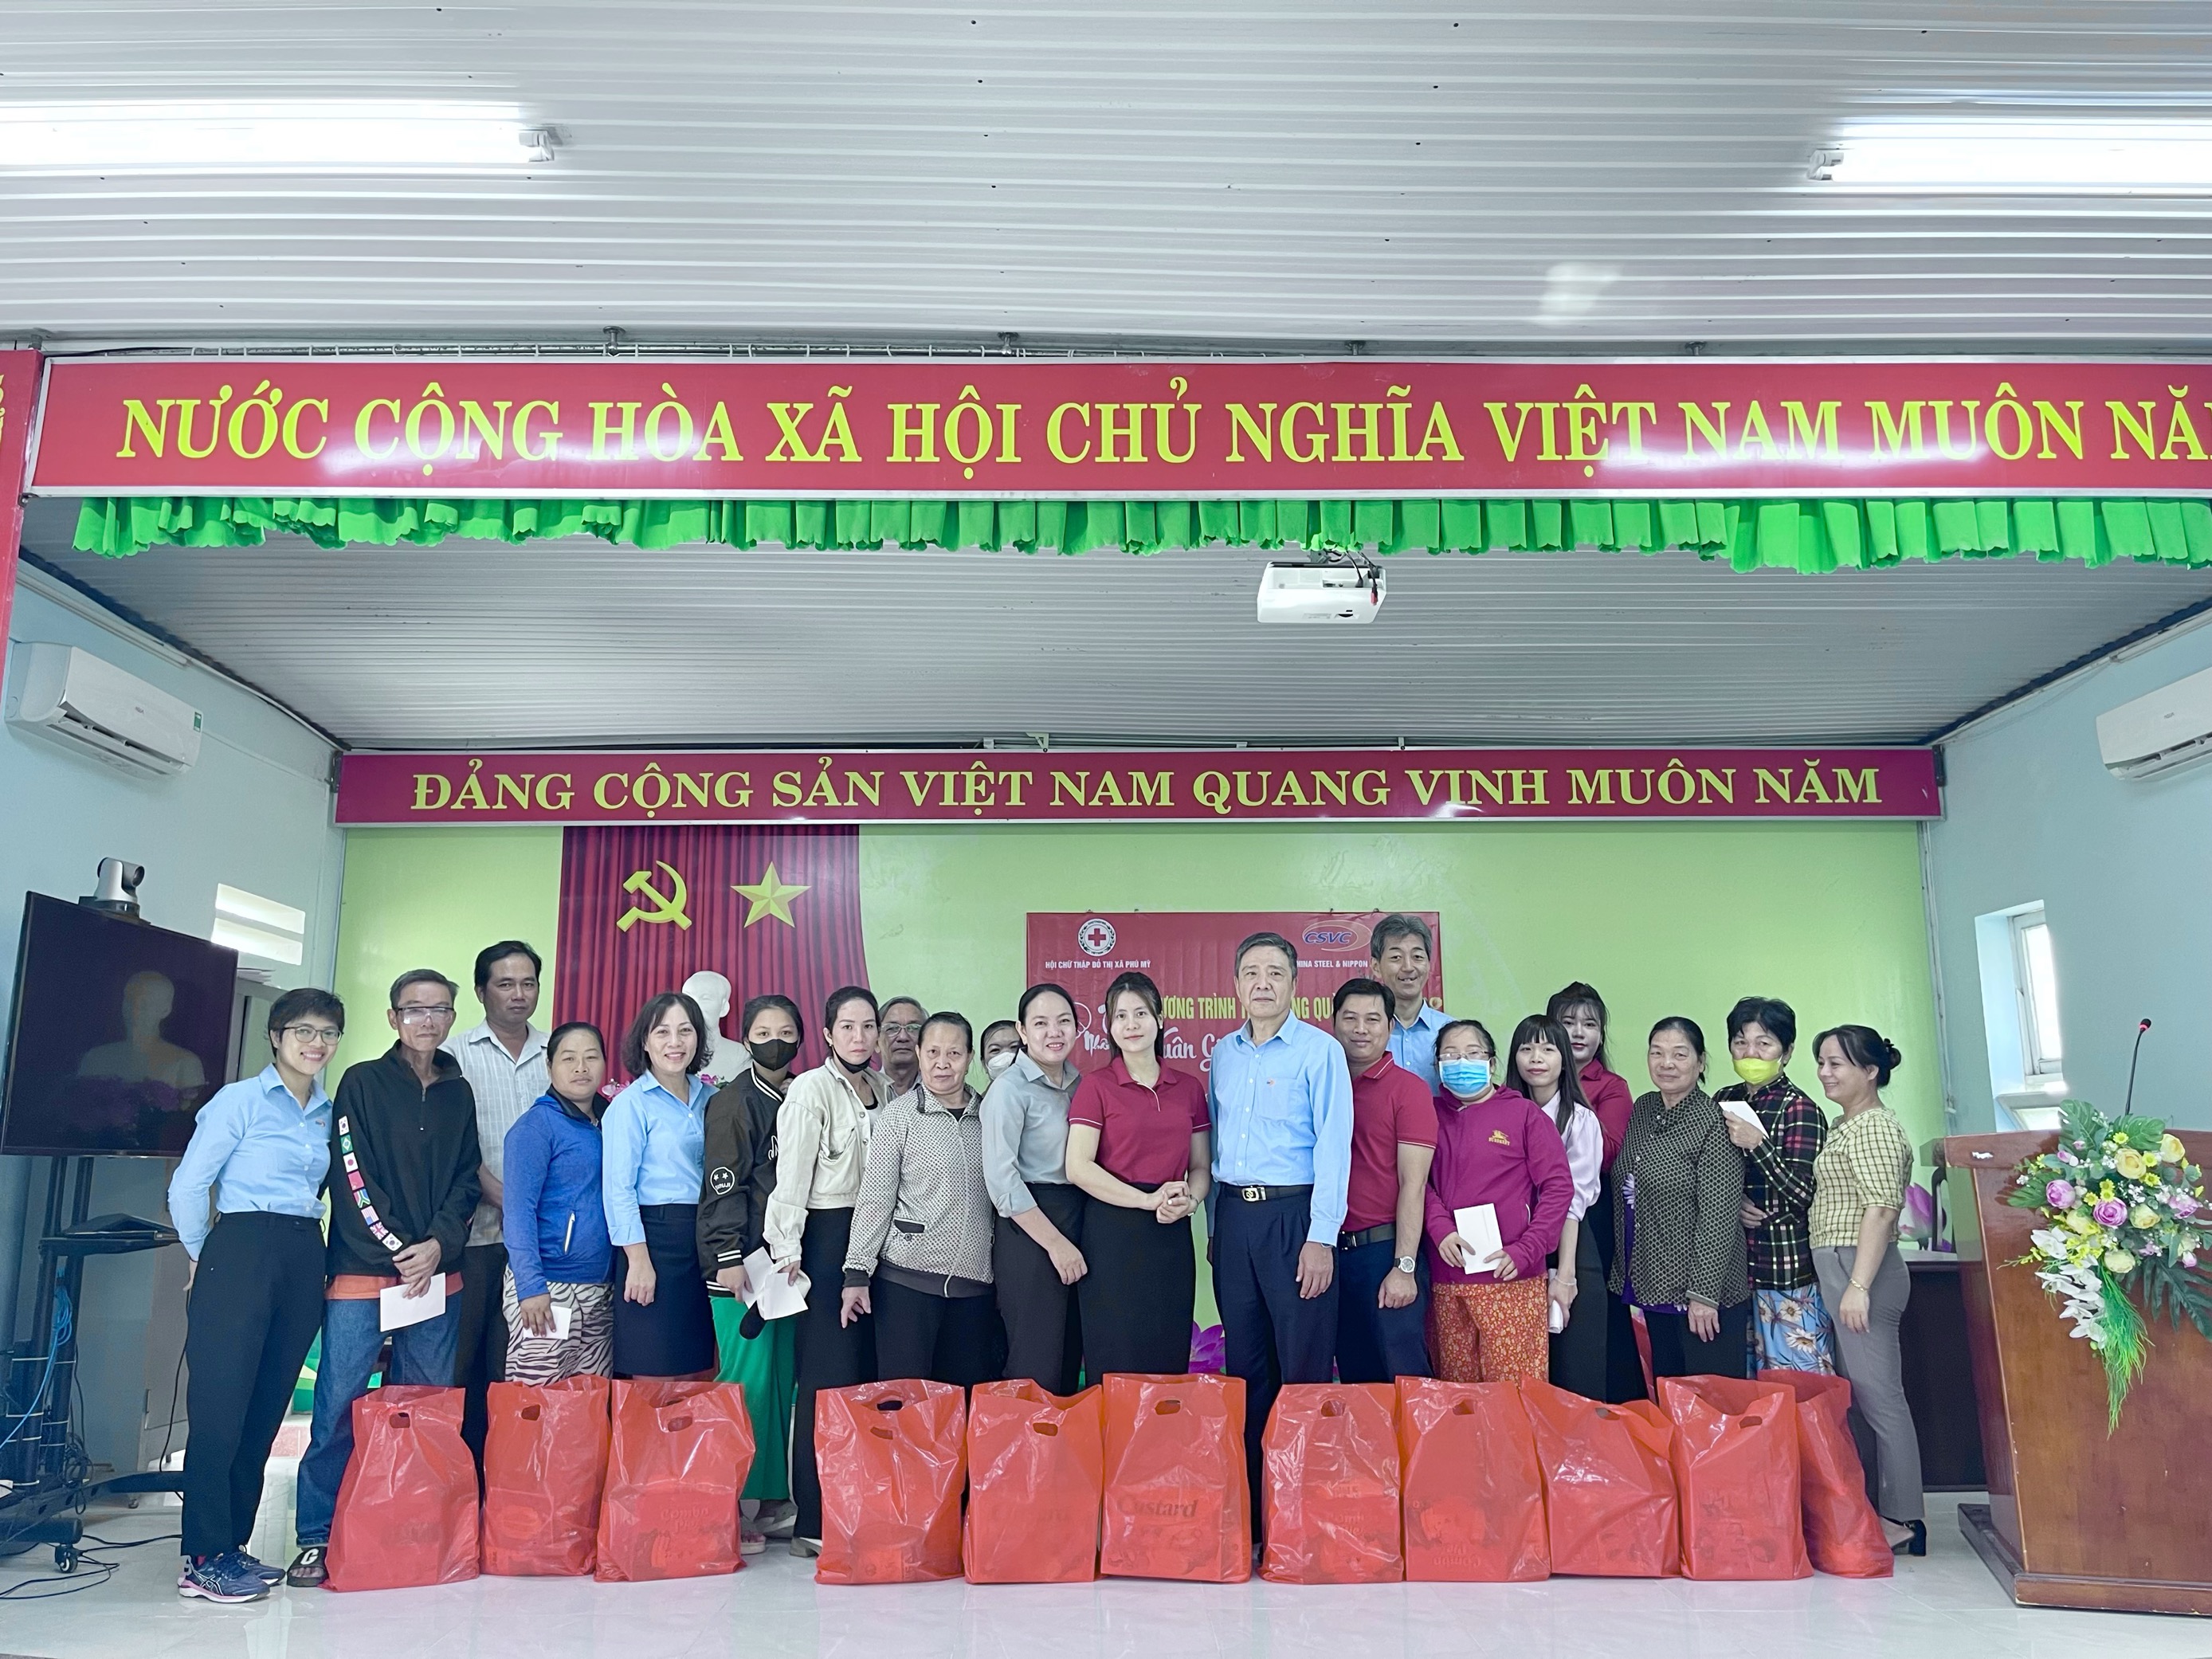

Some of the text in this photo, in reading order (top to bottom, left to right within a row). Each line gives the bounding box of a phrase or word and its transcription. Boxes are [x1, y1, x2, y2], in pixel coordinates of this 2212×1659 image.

[116, 377, 2212, 481] NƯỚC CỘNG HÒA XÃ HỘI CHỦ NGHĨA VIỆT NAM MUÔN NĂ
[410, 756, 1882, 818] ĐẢNG CỘNG SẢN VIỆT NAM QUANG VINH MUÔN NĂM
[1304, 931, 1353, 944] CSVC
[1045, 960, 1057, 970] HỘI
[1058, 959, 1073, 969] CHỮ
[1073, 959, 1090, 970] THẬP
[1103, 960, 1113, 970] THỊ
[1296, 959, 1368, 968] HINA STEEL & NIPPON
[1198, 993, 1235, 1020] TRÌNH
[1313, 993, 1334, 1022] QU
[1163, 1027, 1197, 1060] uân
[300, 1547, 320, 1566] C
